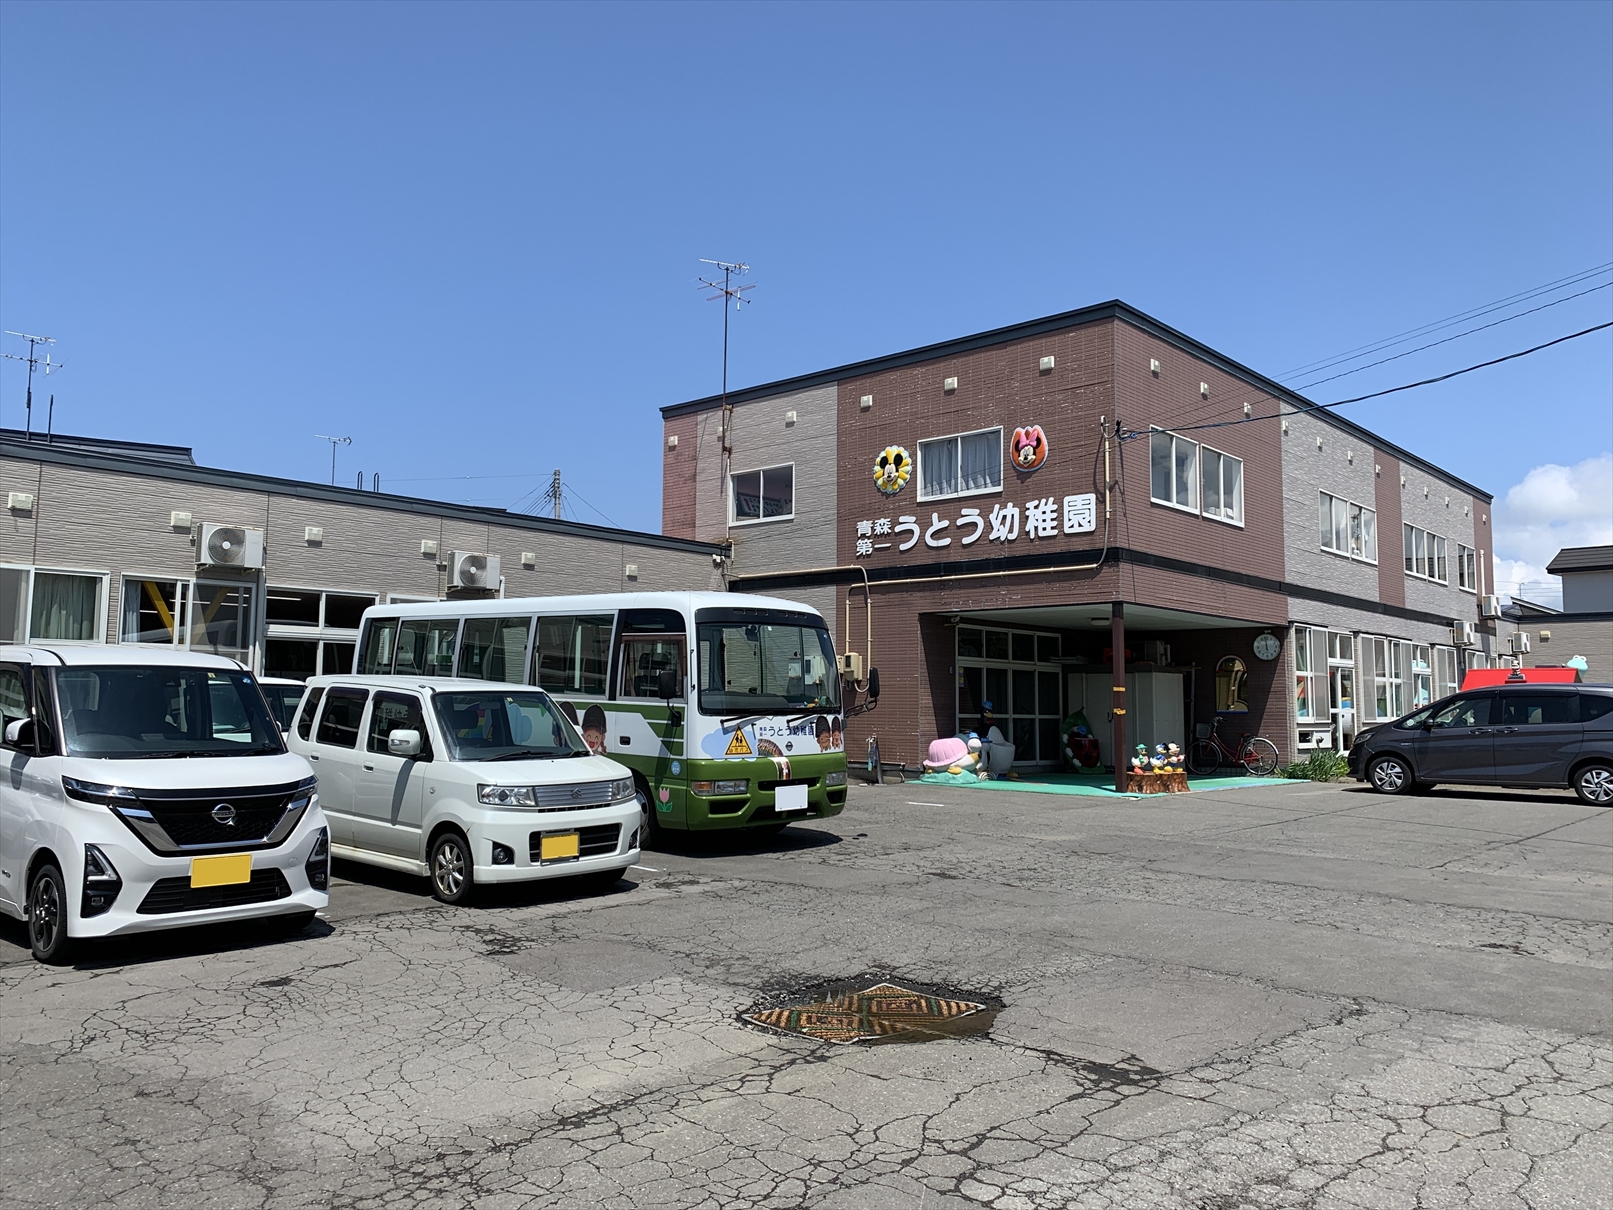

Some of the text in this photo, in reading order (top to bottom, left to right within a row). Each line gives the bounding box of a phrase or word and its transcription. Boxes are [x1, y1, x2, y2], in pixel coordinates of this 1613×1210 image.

[856, 518, 892, 537] 青森
[894, 493, 1096, 551] うとう幼稚園
[856, 539, 892, 556] 第一
